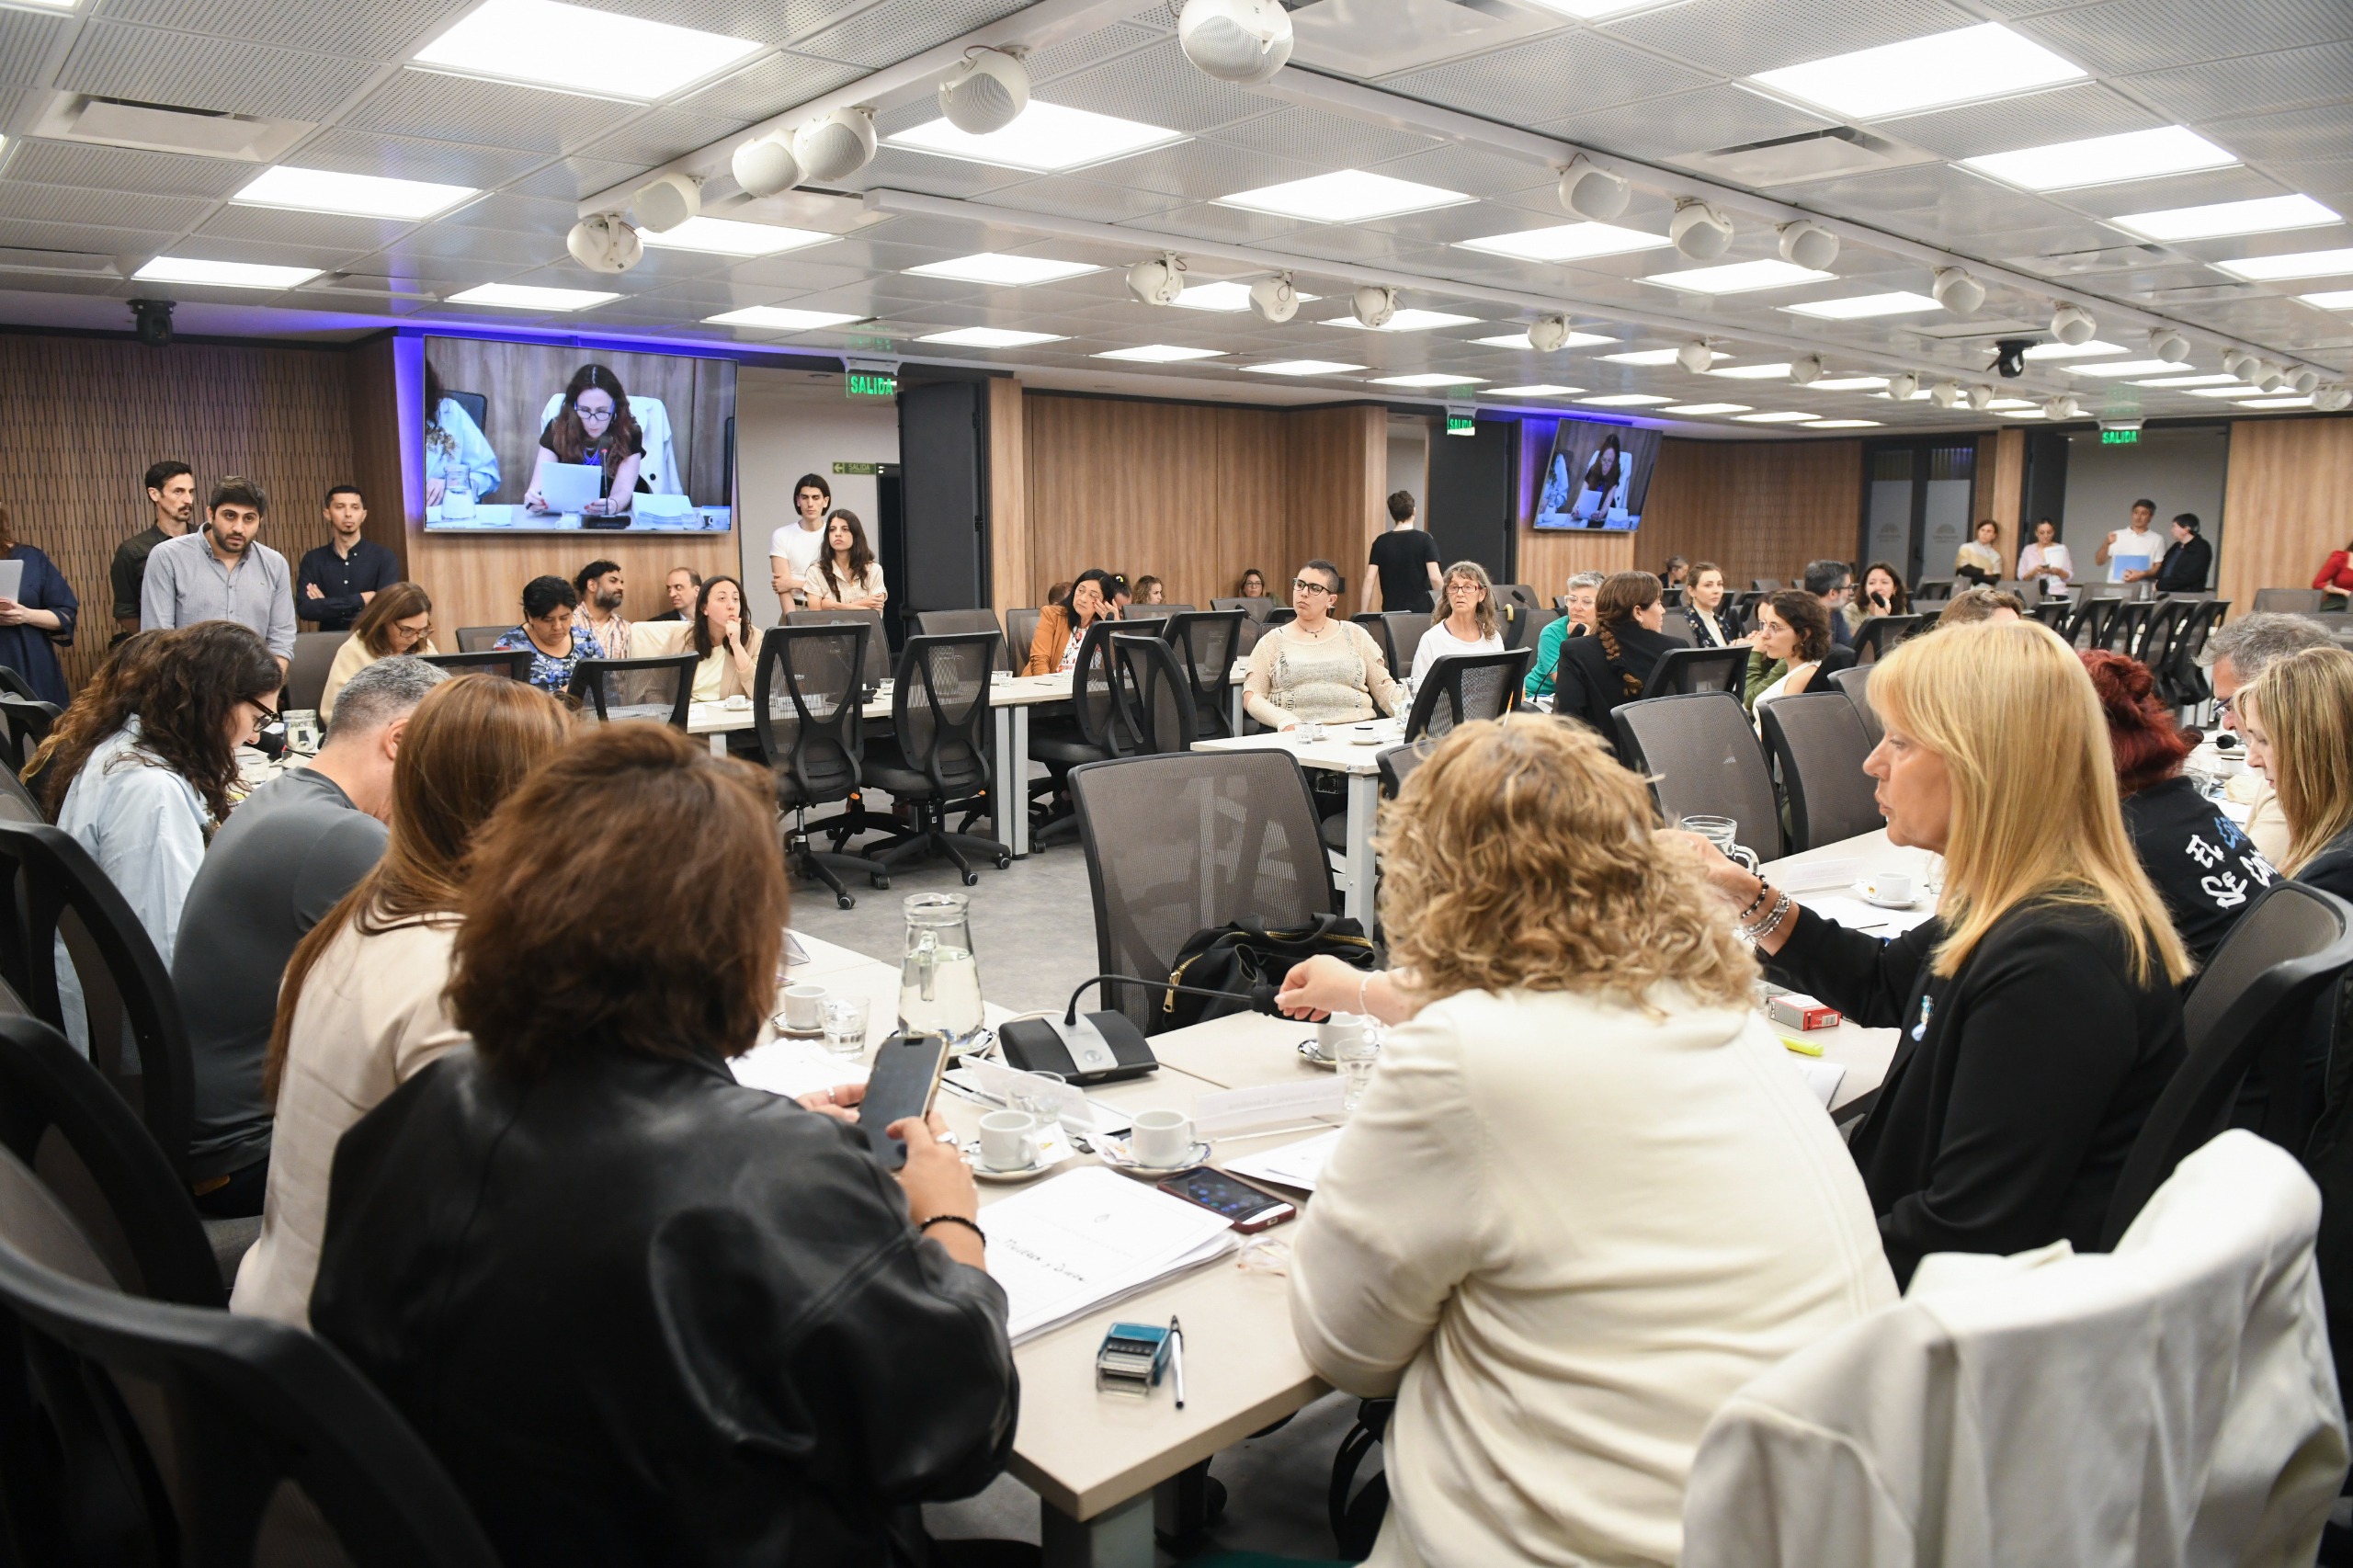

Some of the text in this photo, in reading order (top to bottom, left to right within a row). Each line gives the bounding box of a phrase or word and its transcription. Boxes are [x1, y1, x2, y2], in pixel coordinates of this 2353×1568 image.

[850, 375, 893, 395] SALIDA
[1449, 418, 1472, 429] SALIDA
[2102, 430, 2138, 444] SALIDA
